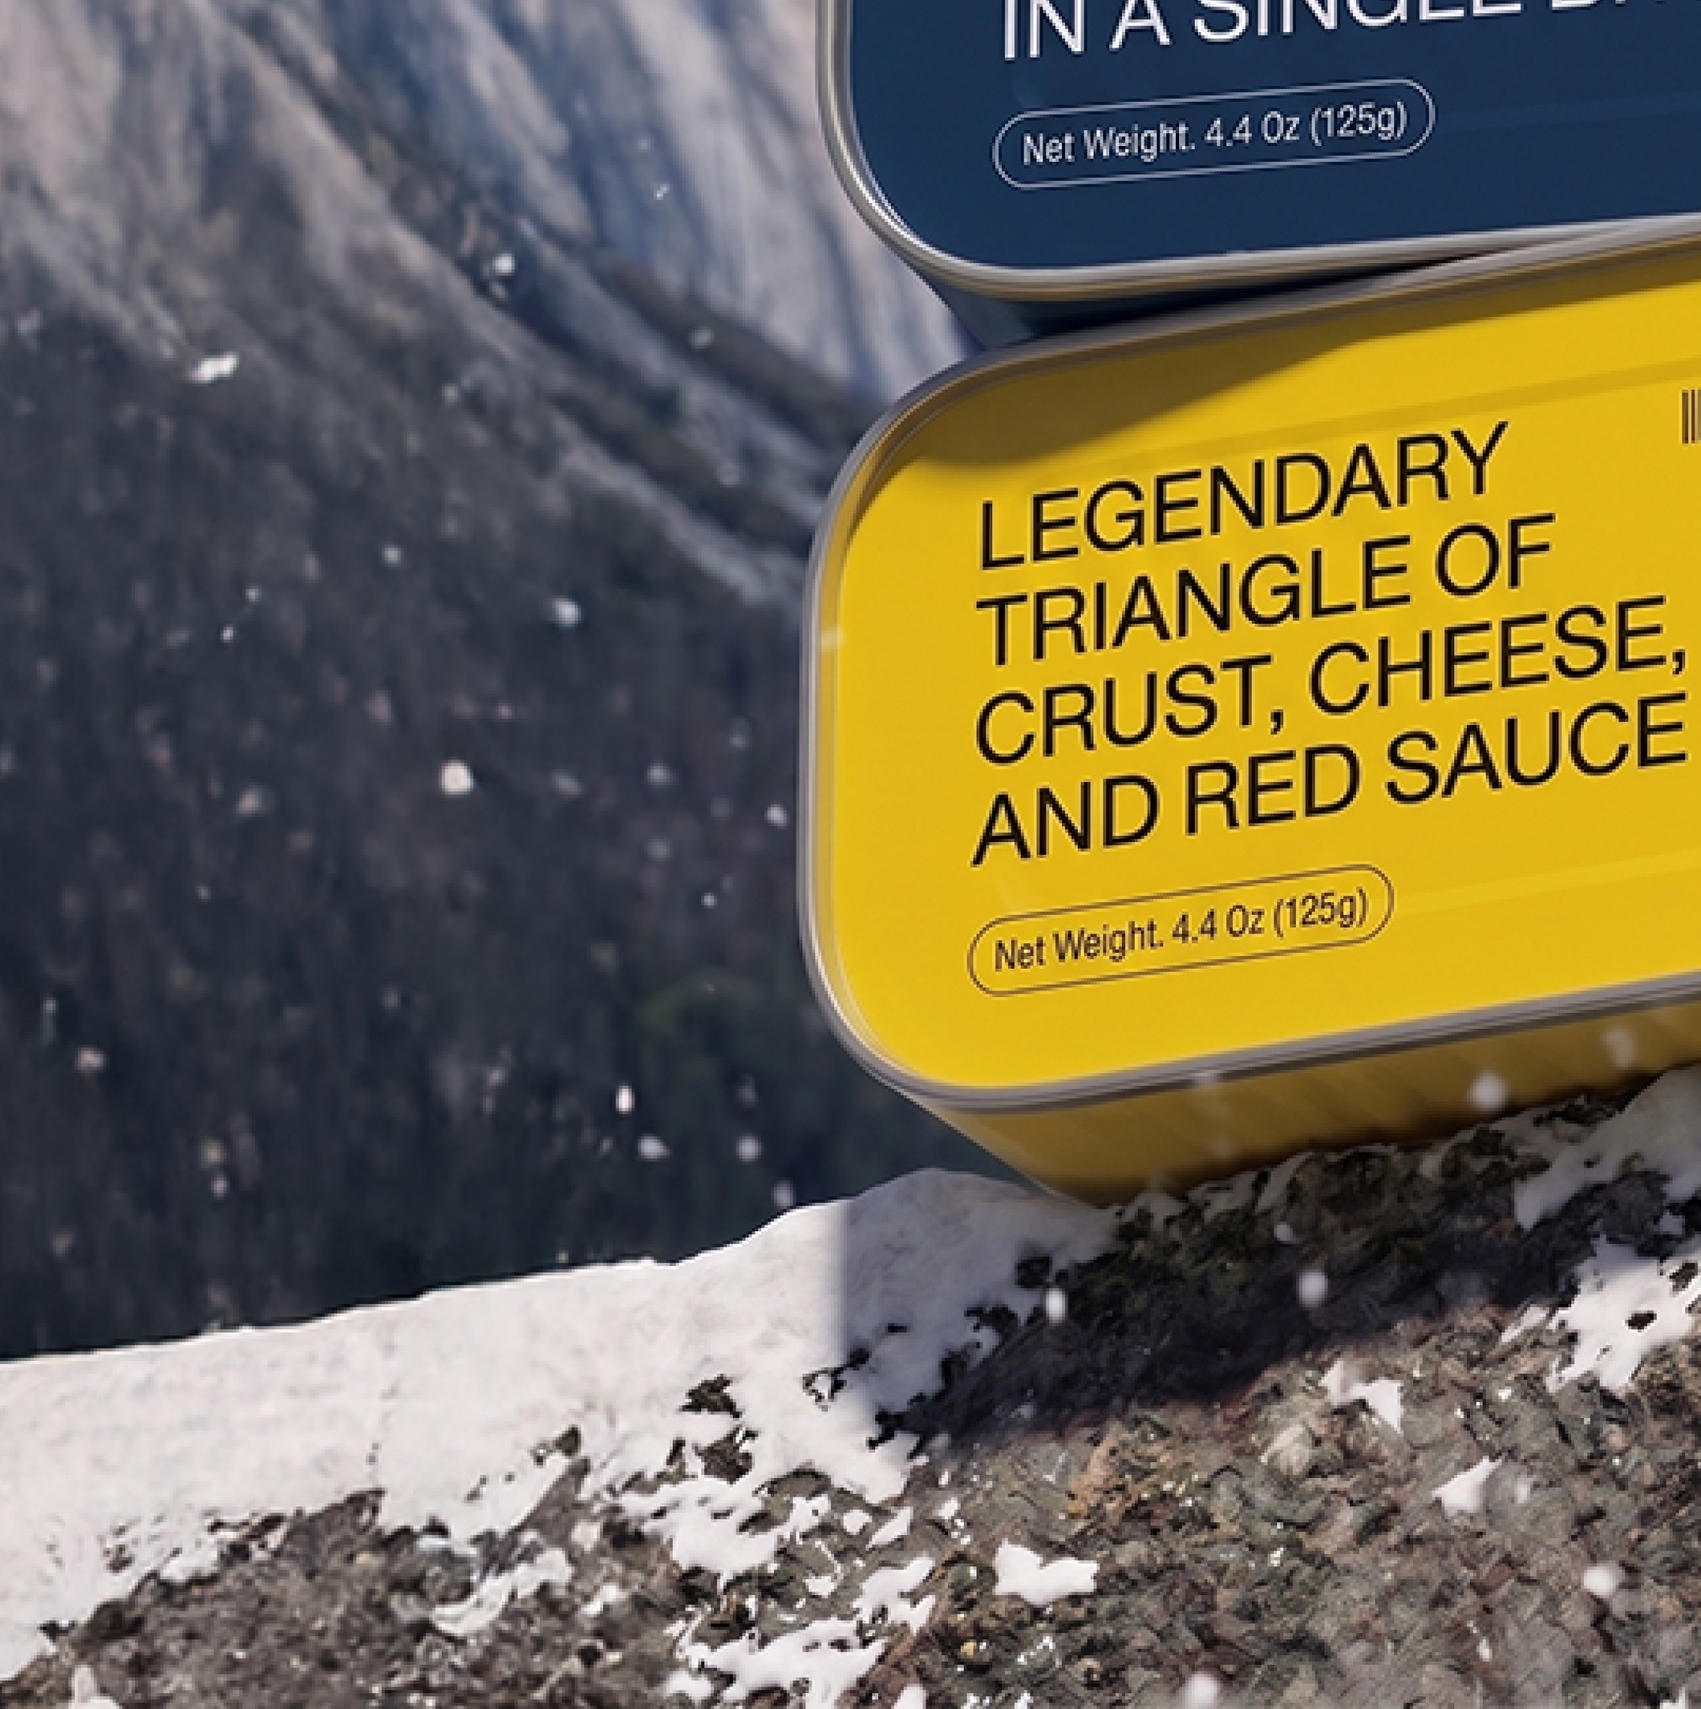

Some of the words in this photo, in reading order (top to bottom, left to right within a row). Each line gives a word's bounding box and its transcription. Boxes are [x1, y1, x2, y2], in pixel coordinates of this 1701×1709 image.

[1024, 133, 1072, 164] Net
[1084, 124, 1195, 162] Weight.
[1205, 115, 1252, 146] 4.4
[1312, 102, 1406, 146] (125g)
[982, 421, 1508, 570] LEGENDARY
[976, 535, 1410, 665] TRIANGLE
[1435, 513, 1555, 596] OF
[976, 655, 1283, 764] CRUST,
[1309, 595, 1685, 715] CHEESE,
[971, 775, 1160, 867] AND
[1186, 744, 1360, 836] RED
[1387, 691, 1686, 804] SAUCE
[995, 937, 1046, 971] Net
[1053, 920, 1163, 962] Weight.
[1172, 909, 1217, 943] 4.4
[1274, 889, 1366, 937] (125g)
